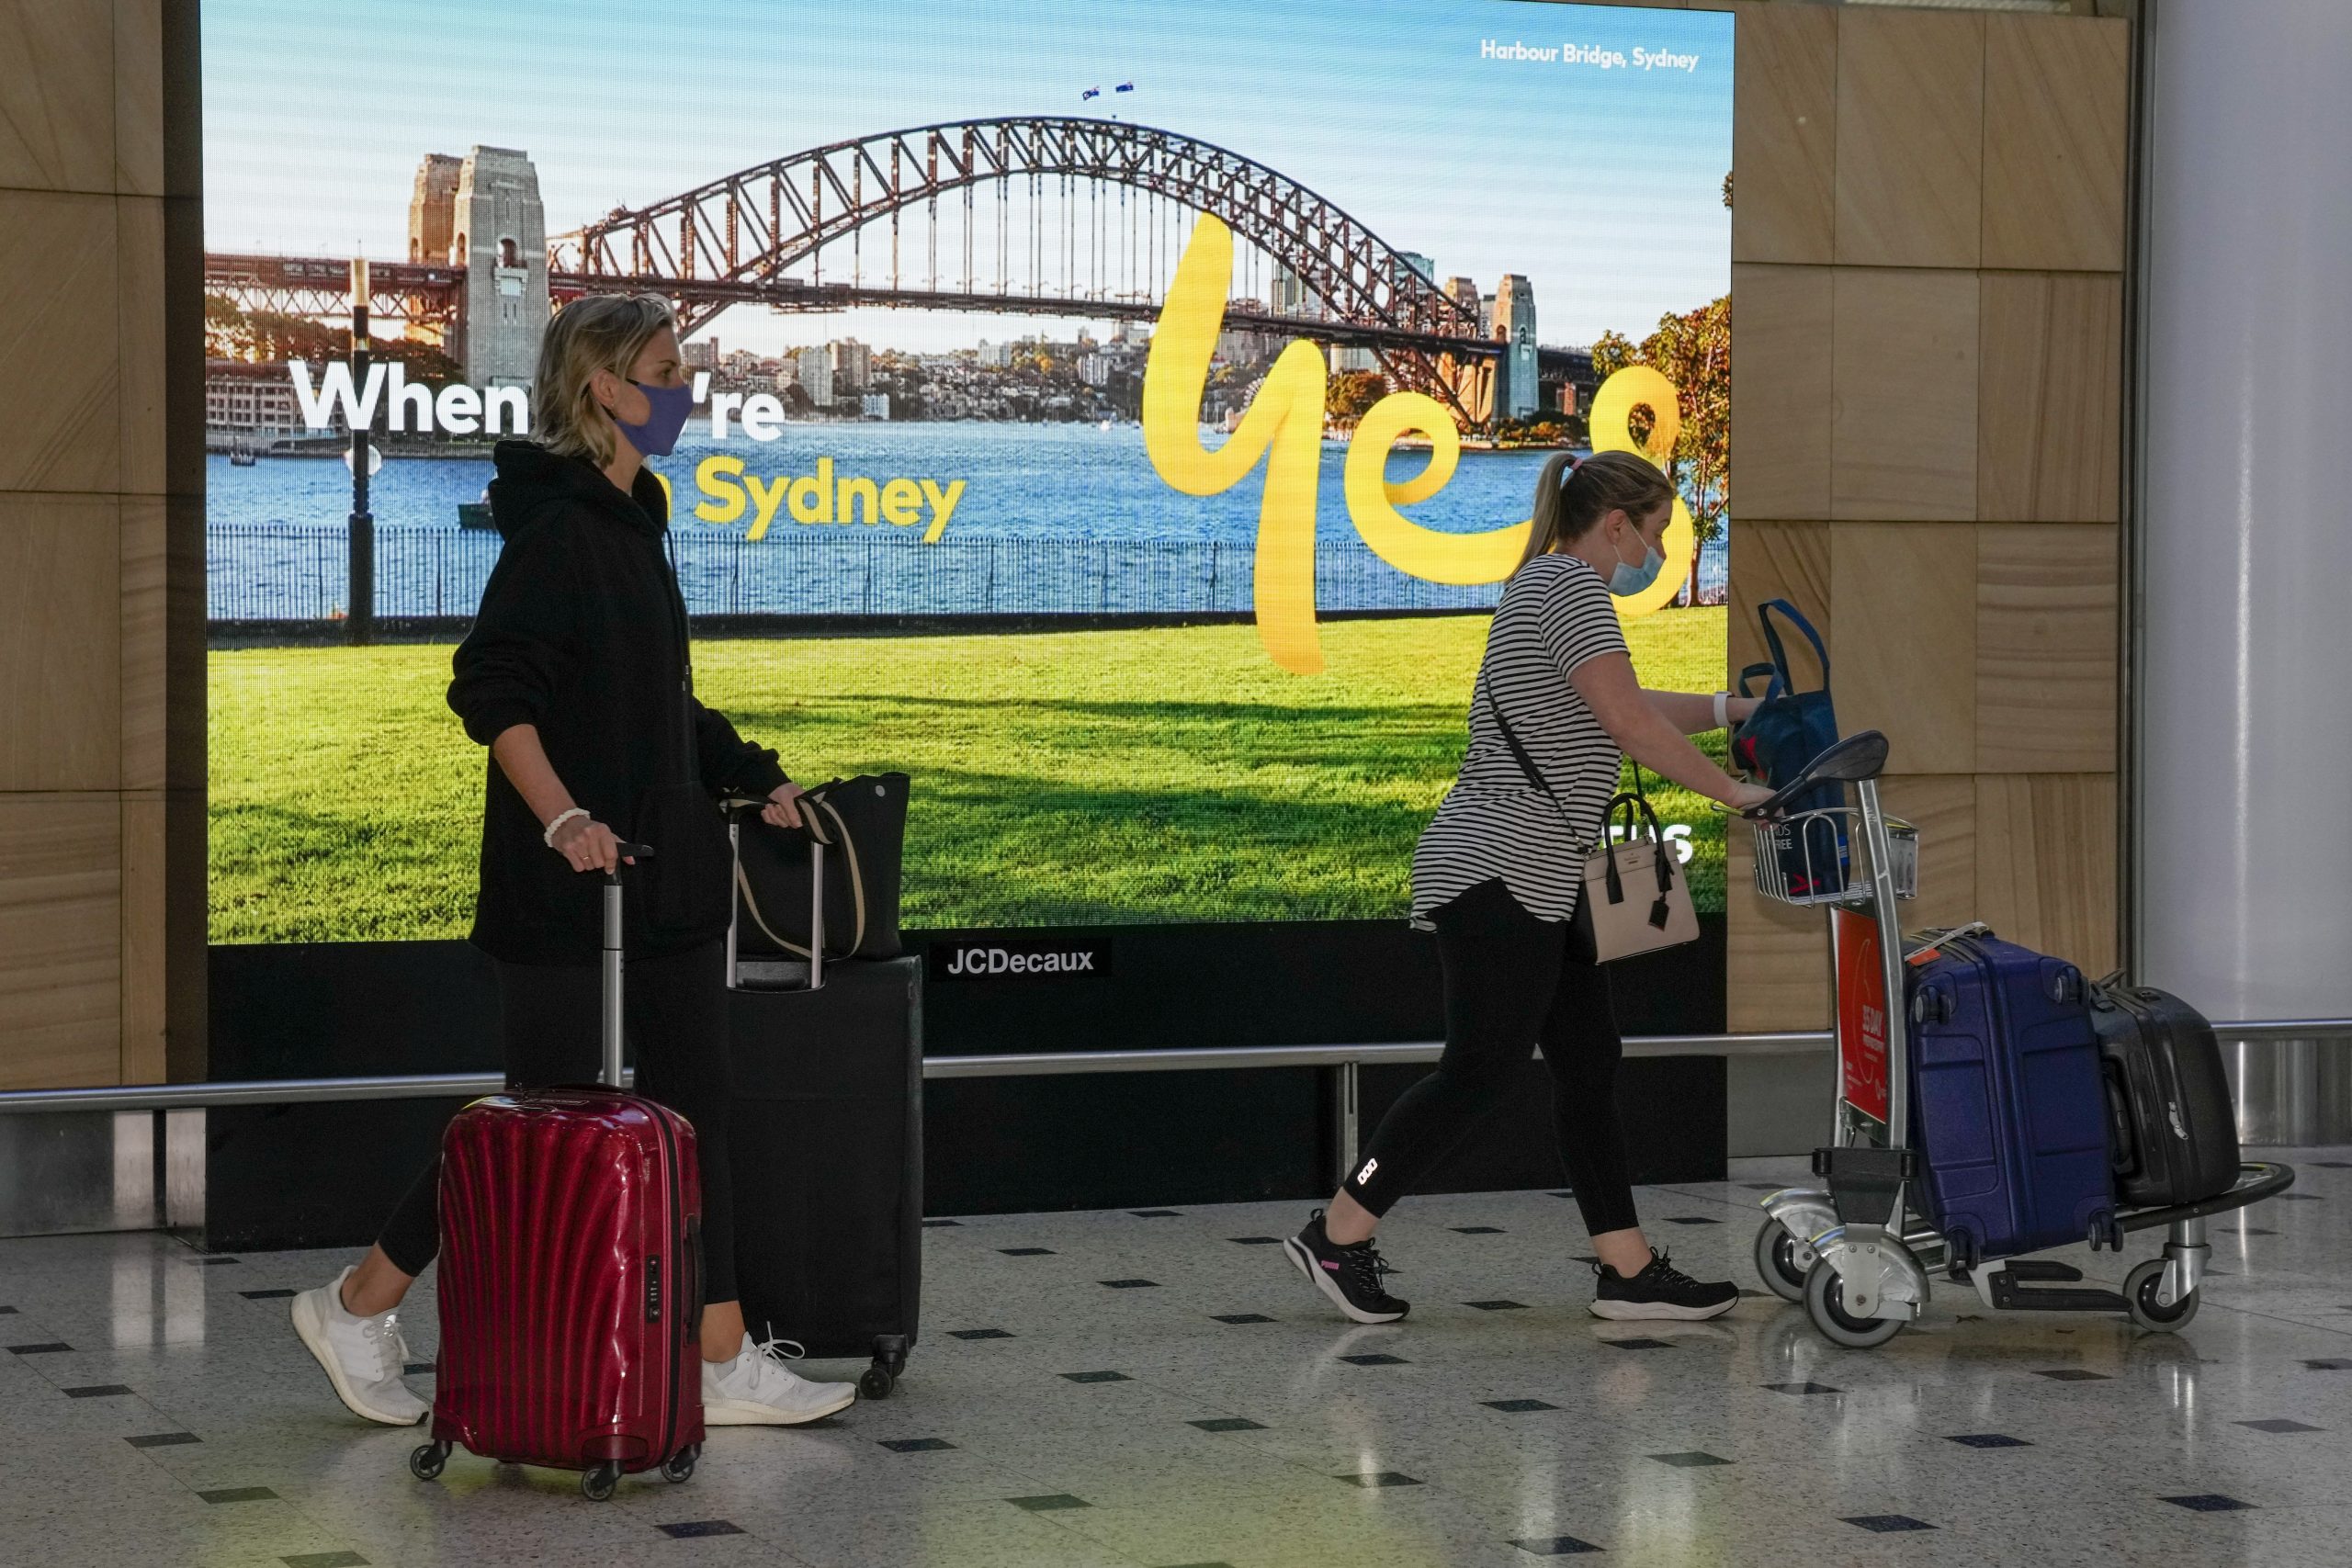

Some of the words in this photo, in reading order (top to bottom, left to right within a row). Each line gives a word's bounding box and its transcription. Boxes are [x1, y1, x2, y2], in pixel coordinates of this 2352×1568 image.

[1480, 39, 1558, 62] Harbour
[1564, 43, 1626, 69] Bridge,
[1633, 47, 1699, 73] Sydney
[288, 359, 528, 434] When
[694, 457, 967, 544] Sydney
[947, 948, 1094, 975] JCDecaux
